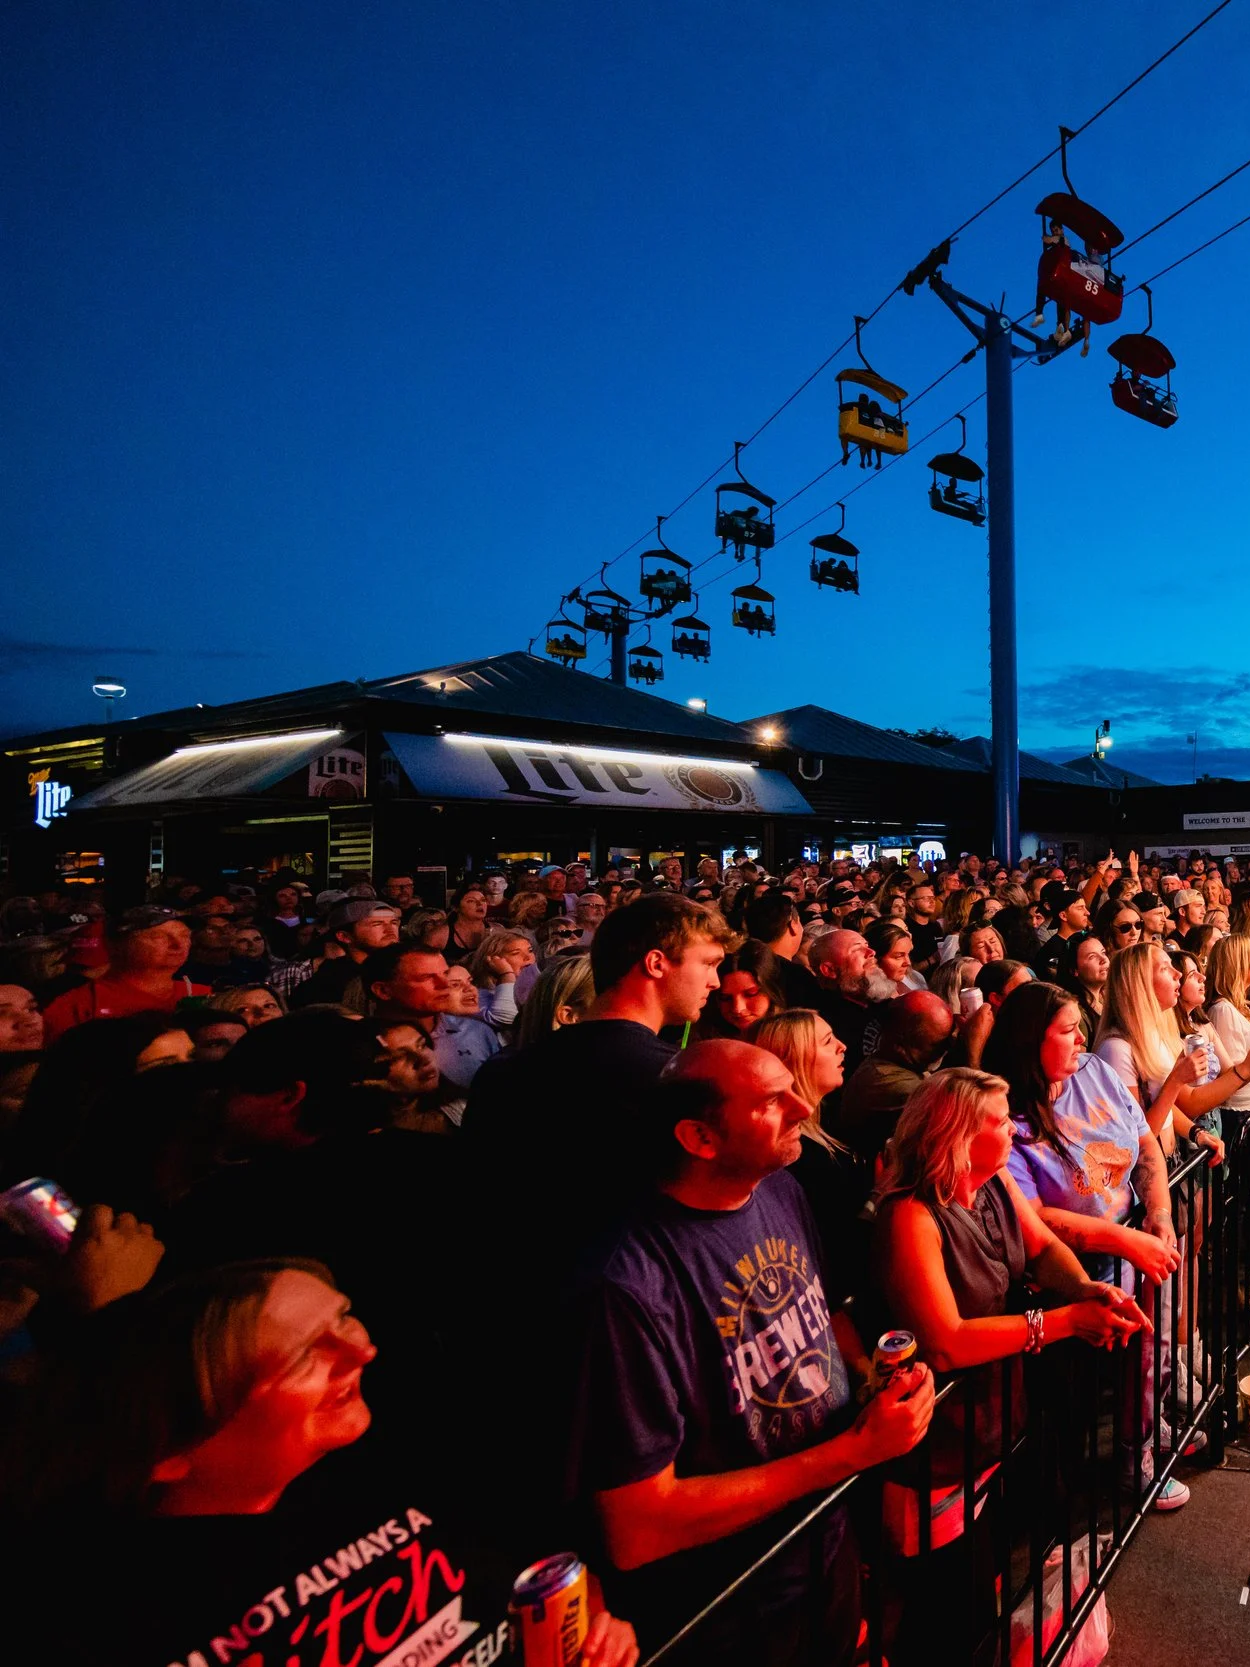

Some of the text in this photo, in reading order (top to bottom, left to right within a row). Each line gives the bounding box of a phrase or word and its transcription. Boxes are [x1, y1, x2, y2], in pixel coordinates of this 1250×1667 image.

[1085, 279, 1099, 296] 85
[316, 755, 363, 778] Lite
[482, 743, 651, 803] Lite
[35, 781, 71, 829] Lite
[1188, 817, 1220, 825] WELCOME
[715, 1237, 808, 1338] MILWAUKEE
[210, 1507, 433, 1665] NOT ALWAYS A
[392, 1618, 459, 1667] DING
[450, 1619, 509, 1667] SELF
